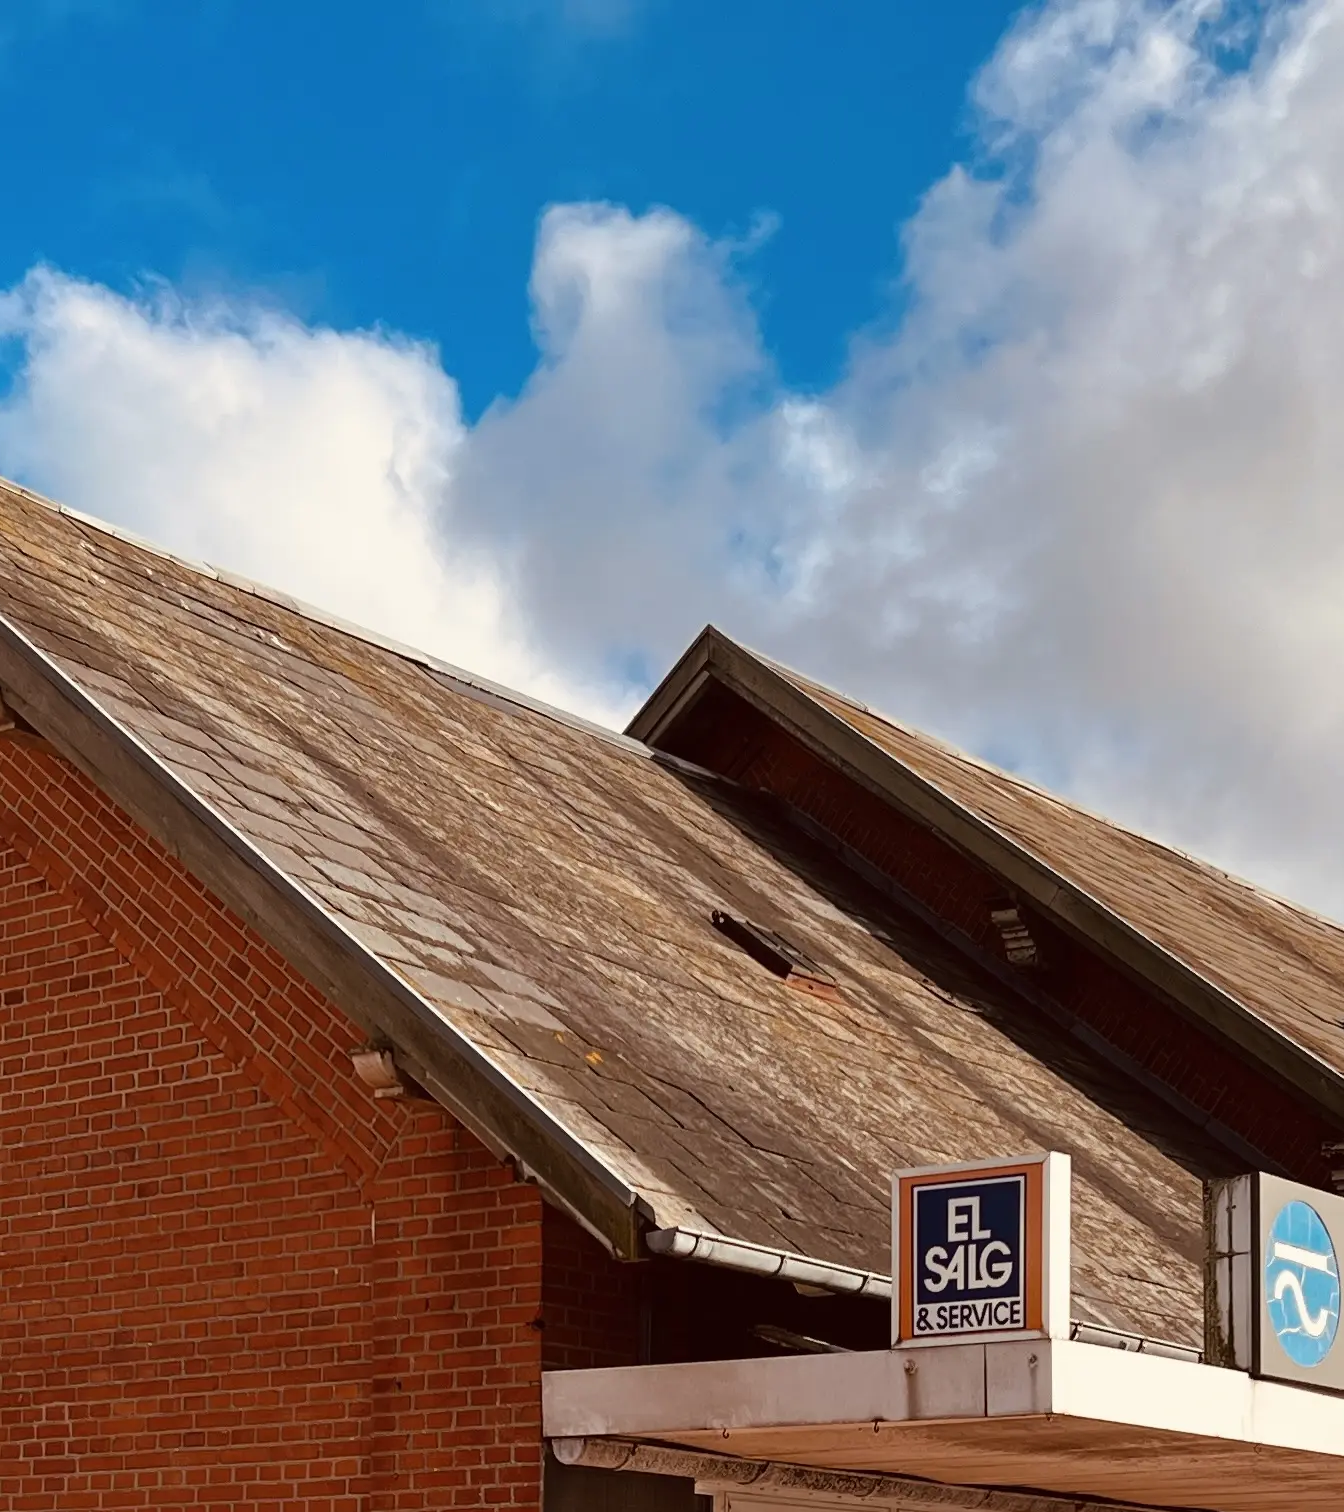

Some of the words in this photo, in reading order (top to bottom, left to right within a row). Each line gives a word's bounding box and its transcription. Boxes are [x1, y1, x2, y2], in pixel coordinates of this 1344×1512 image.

[947, 1196, 991, 1241] EL
[923, 1240, 1013, 1292] SALG
[916, 1307, 934, 1331] &
[936, 1301, 1020, 1330] SERVICE
